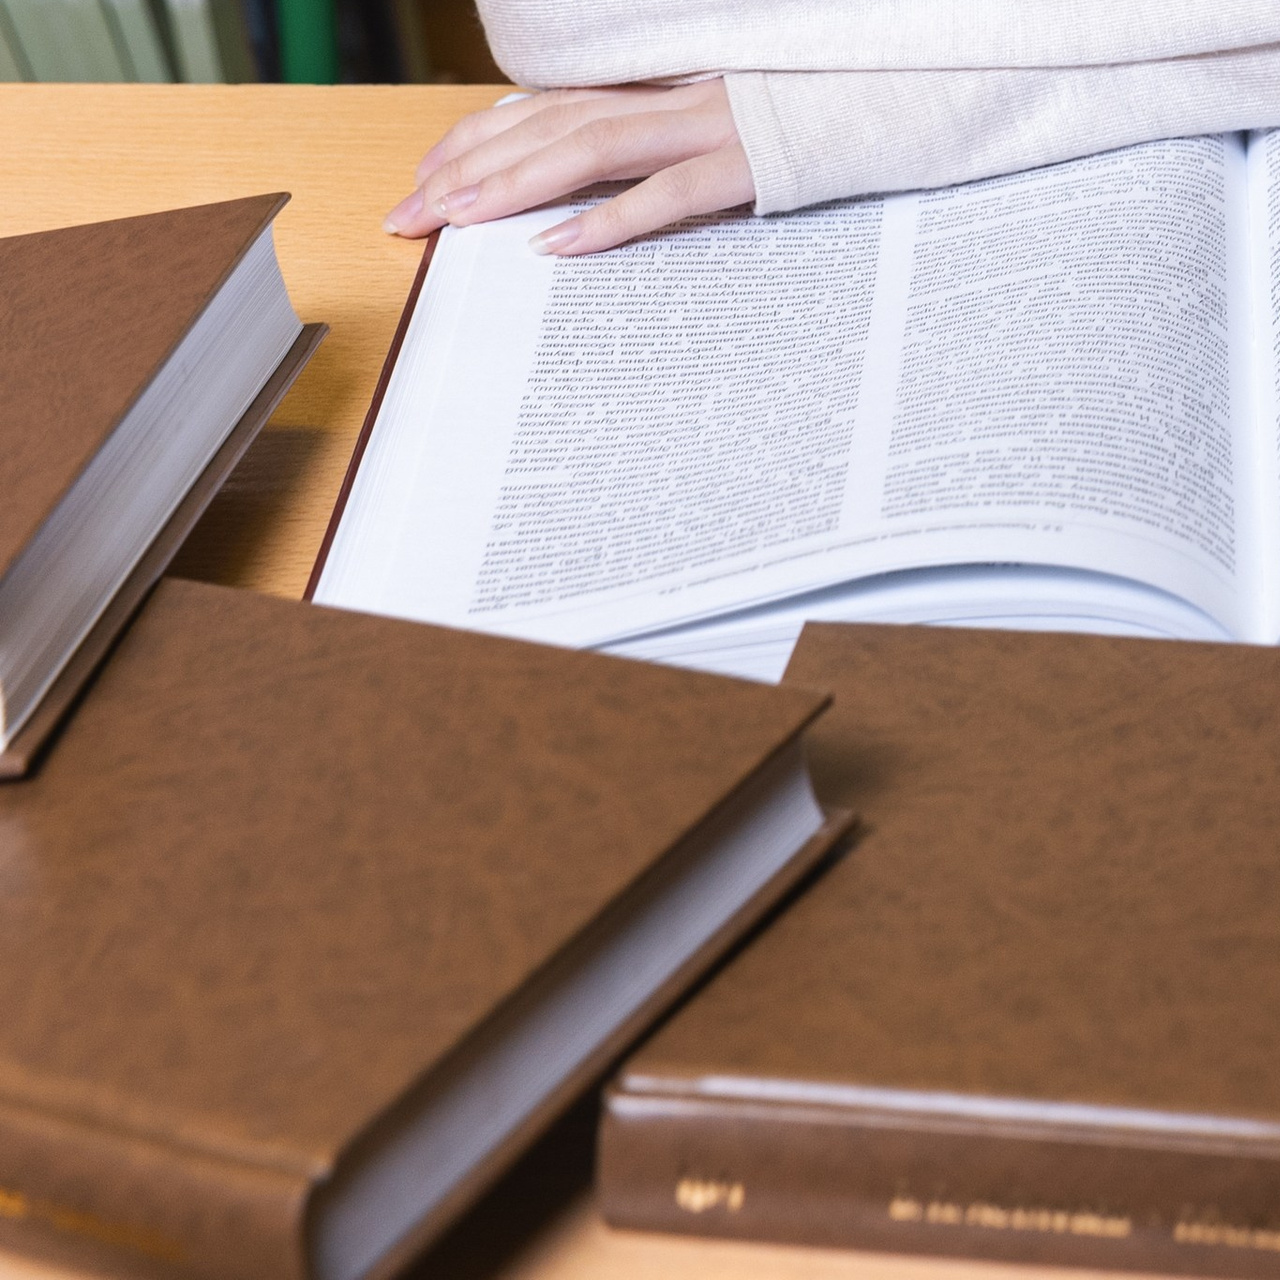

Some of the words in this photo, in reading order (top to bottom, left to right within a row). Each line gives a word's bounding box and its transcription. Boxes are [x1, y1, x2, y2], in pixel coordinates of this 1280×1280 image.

[826, 262, 877, 276] устроен
[786, 271, 822, 279] таким
[691, 282, 736, 290] других
[756, 274, 854, 288] возникающими
[582, 284, 637, 292] Поэтому
[793, 282, 846, 293] которое
[622, 291, 676, 299] другими
[690, 288, 789, 298] ассоциируется
[780, 293, 815, 301] затем
[596, 300, 688, 308] возбуждается
[787, 299, 825, 308] Звуки
[826, 296, 874, 310] буются
[682, 309, 781, 322] формирования
[838, 320, 871, 334] руют
[650, 345, 722, 355] требуемые
[735, 340, 820, 358] посредством
[777, 335, 869, 359] посредством
[619, 356, 668, 365] органы
[670, 353, 732, 363] которого
[703, 355, 773, 368] созерцания
[763, 357, 802, 368] Когда
[573, 365, 654, 374] приводимся
[657, 363, 699, 373] вещей
[680, 367, 737, 378] впервые
[597, 373, 677, 382] изобретаем
